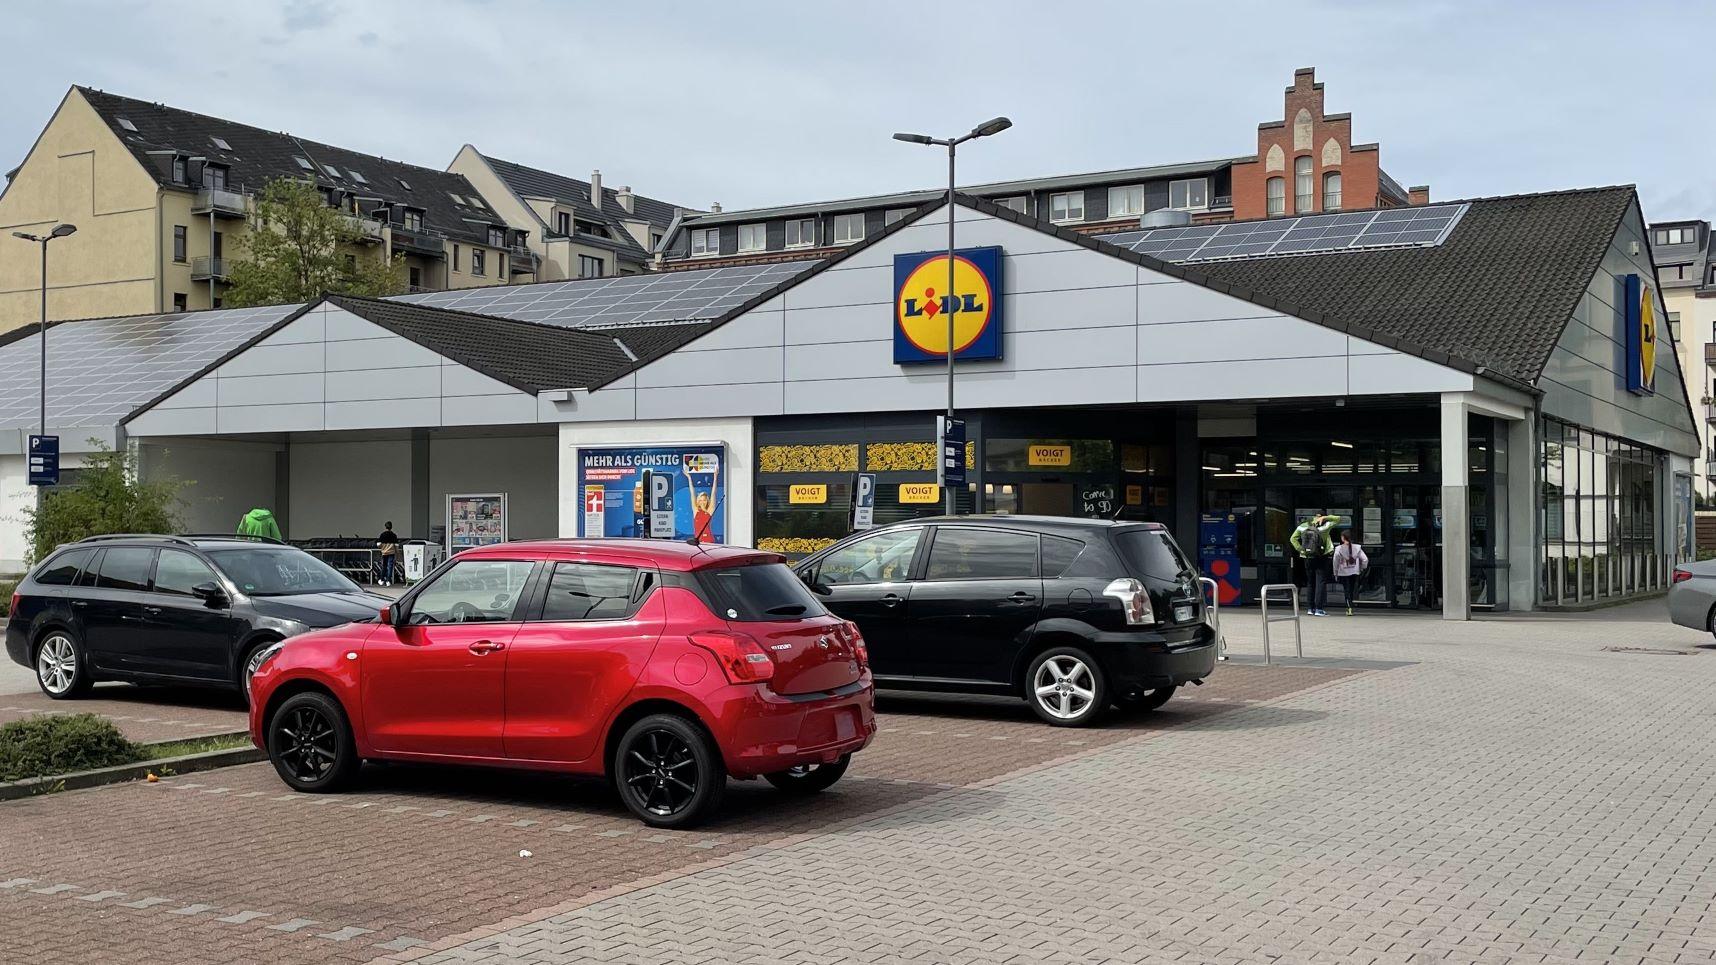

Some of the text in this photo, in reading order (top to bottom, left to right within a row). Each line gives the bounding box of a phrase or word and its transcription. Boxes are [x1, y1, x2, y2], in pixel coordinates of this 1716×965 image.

[946, 419, 952, 433] P
[32, 438, 39, 448] P
[1035, 449, 1065, 457] VOIGT
[584, 452, 680, 467] MEHR ALS GÜNSTIG
[653, 475, 669, 510] P
[795, 487, 821, 495] VOIGT
[857, 476, 871, 506] P
[905, 486, 933, 494] VOIGT
[1084, 501, 1095, 512] to
